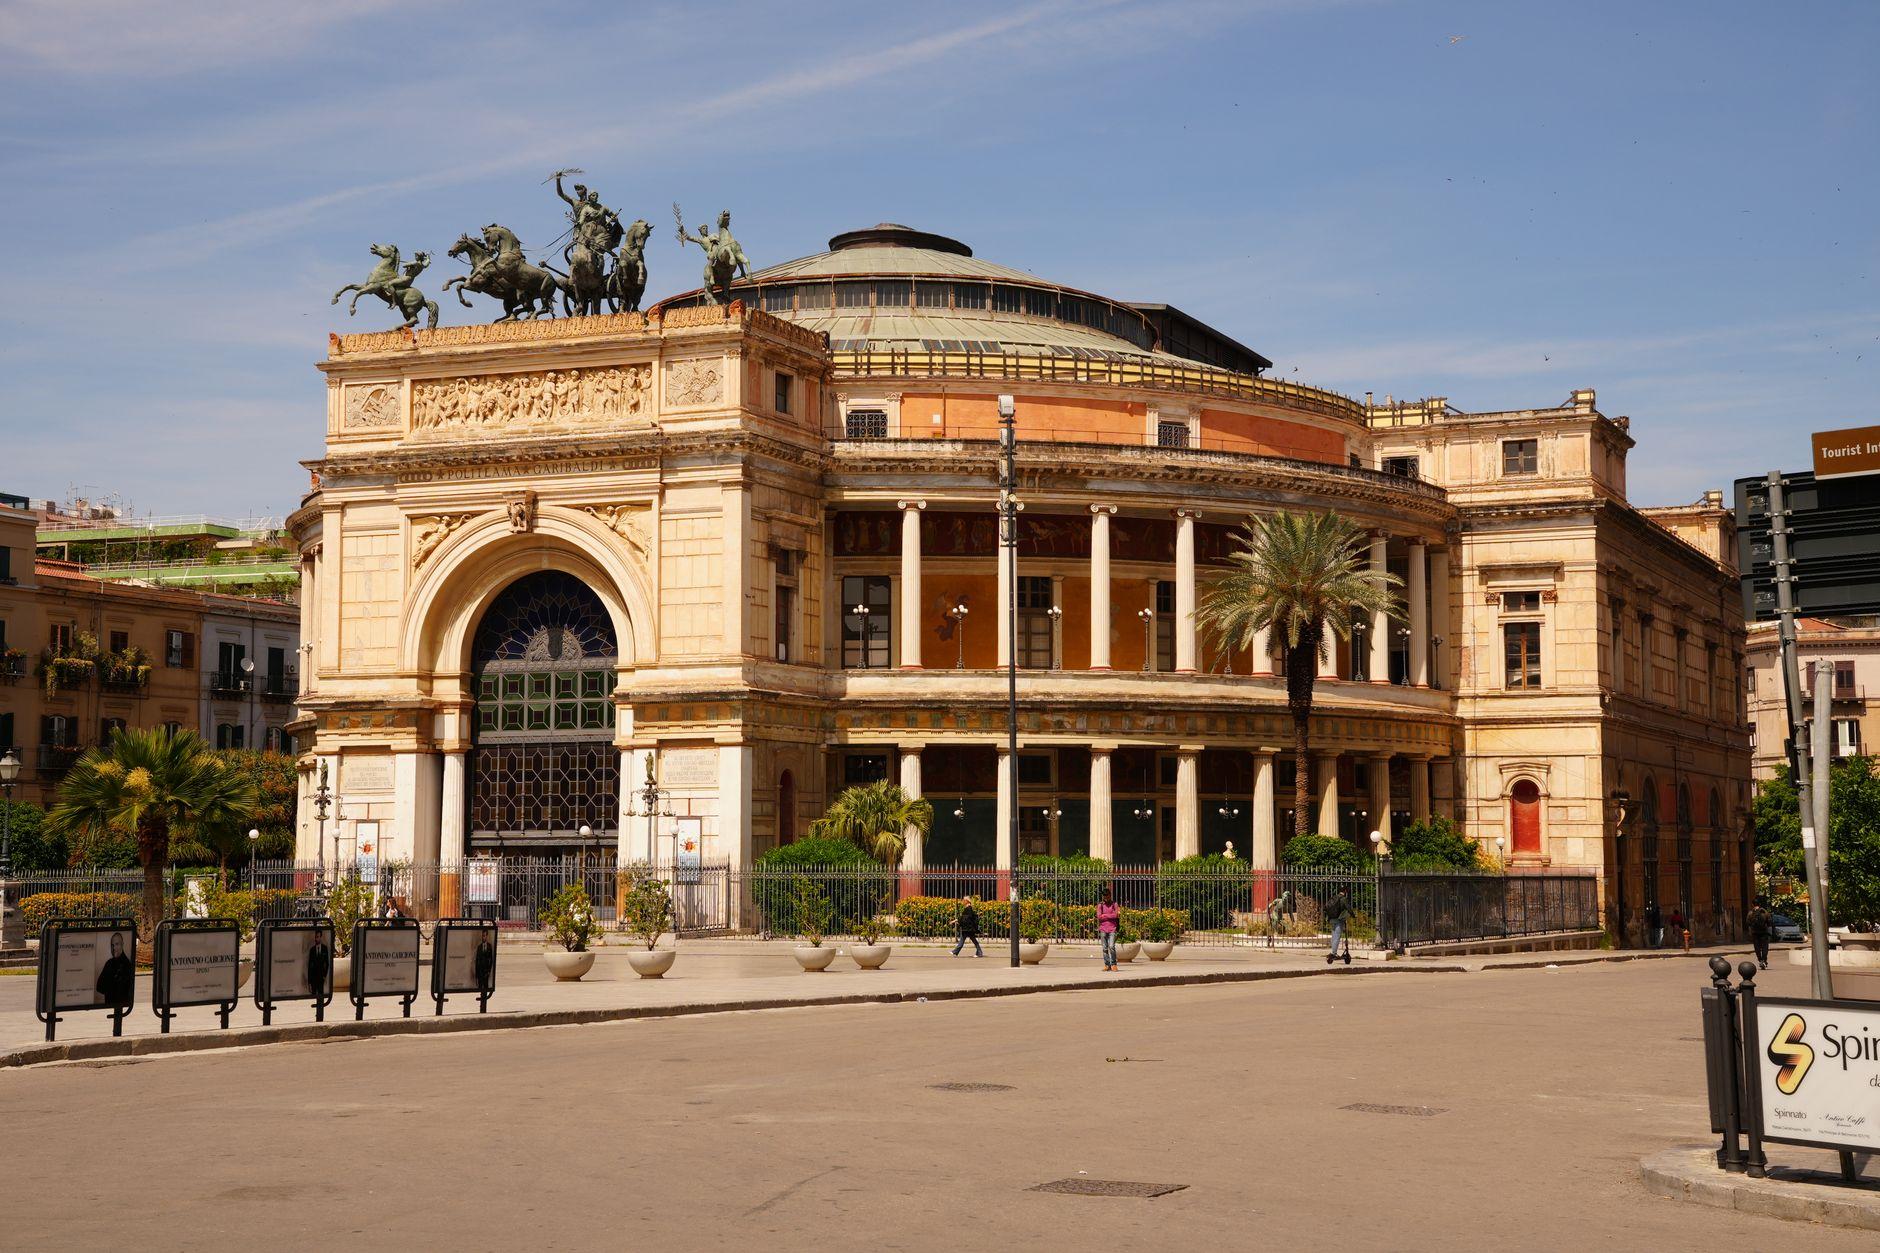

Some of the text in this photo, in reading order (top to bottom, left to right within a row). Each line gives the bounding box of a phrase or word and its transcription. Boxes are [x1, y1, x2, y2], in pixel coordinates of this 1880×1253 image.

[1821, 443, 1862, 459] Tourist
[447, 460, 604, 480] POLITEAMA GARIBALDI
[1774, 1107, 1807, 1119] Spinnato
